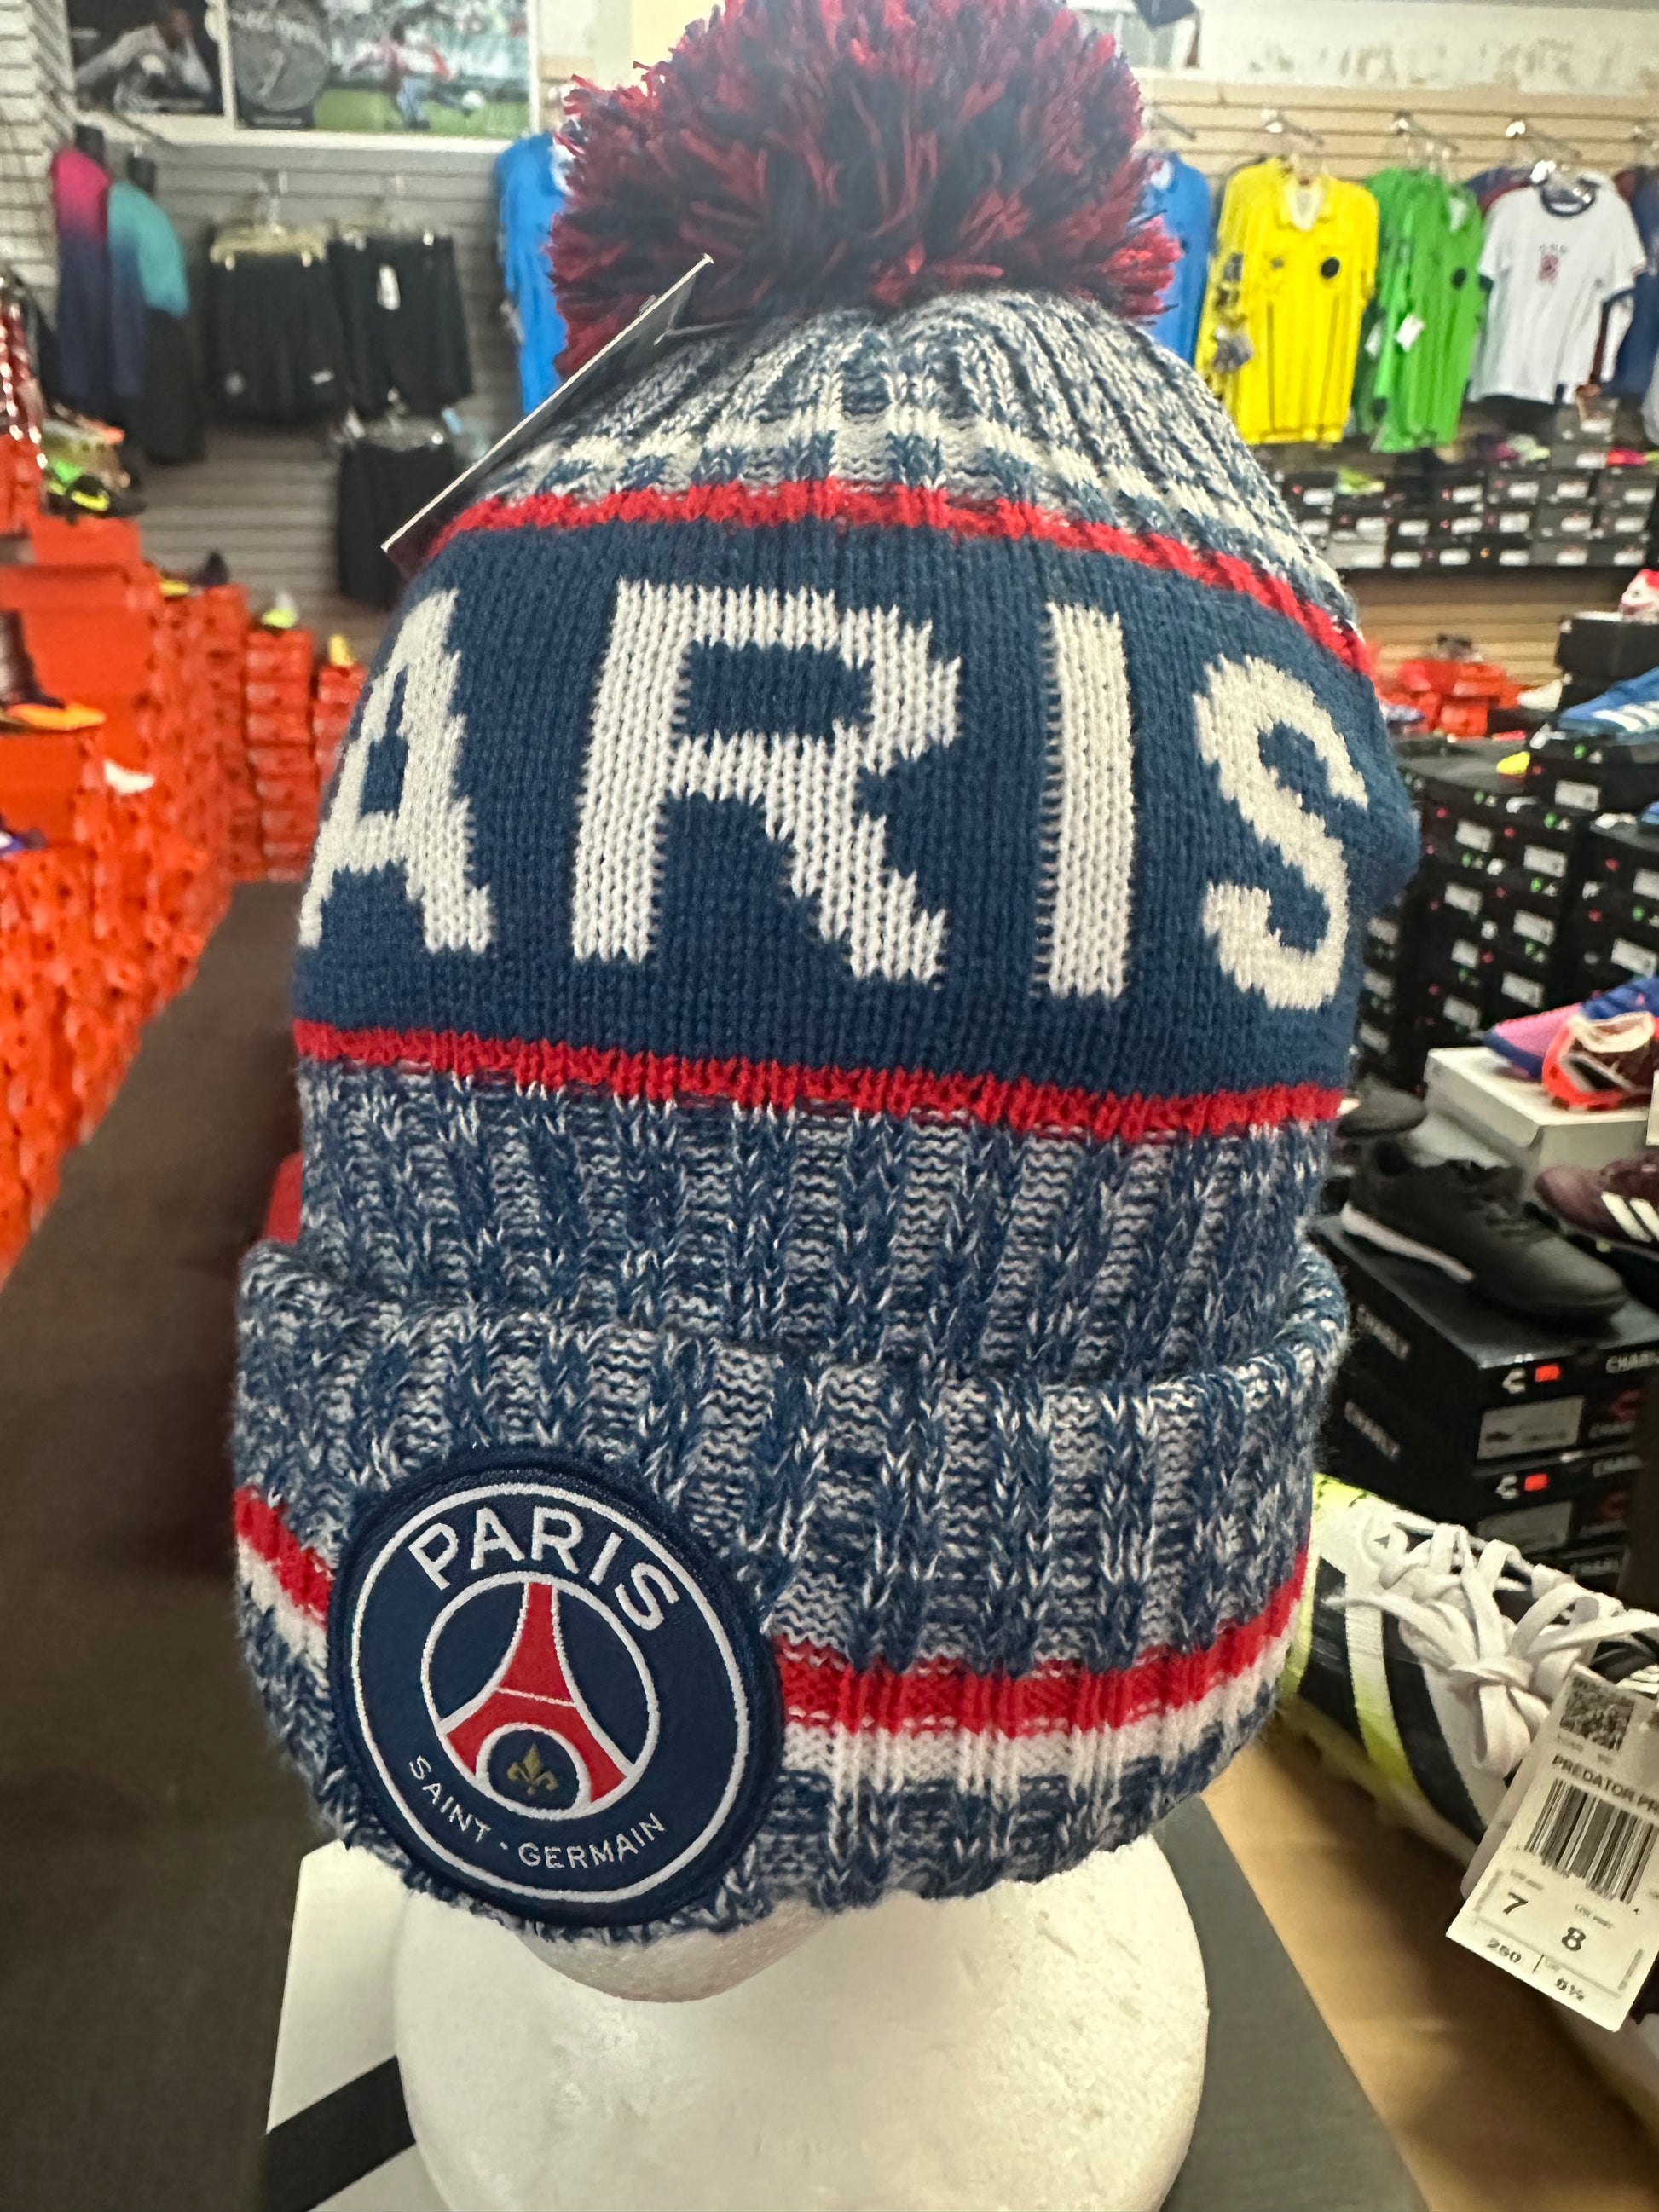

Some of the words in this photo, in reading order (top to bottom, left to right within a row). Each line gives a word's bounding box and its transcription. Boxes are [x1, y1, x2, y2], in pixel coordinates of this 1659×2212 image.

[298, 579, 1369, 1011] ARIS
[408, 1505, 680, 1631] PARIS
[408, 1756, 491, 1843] SAINT
[517, 1812, 665, 1868] GERMAIN
[1552, 1753, 1635, 1802] PREDATOR
[1502, 1891, 1529, 1915] 7
[1561, 1926, 1587, 1952] 8
